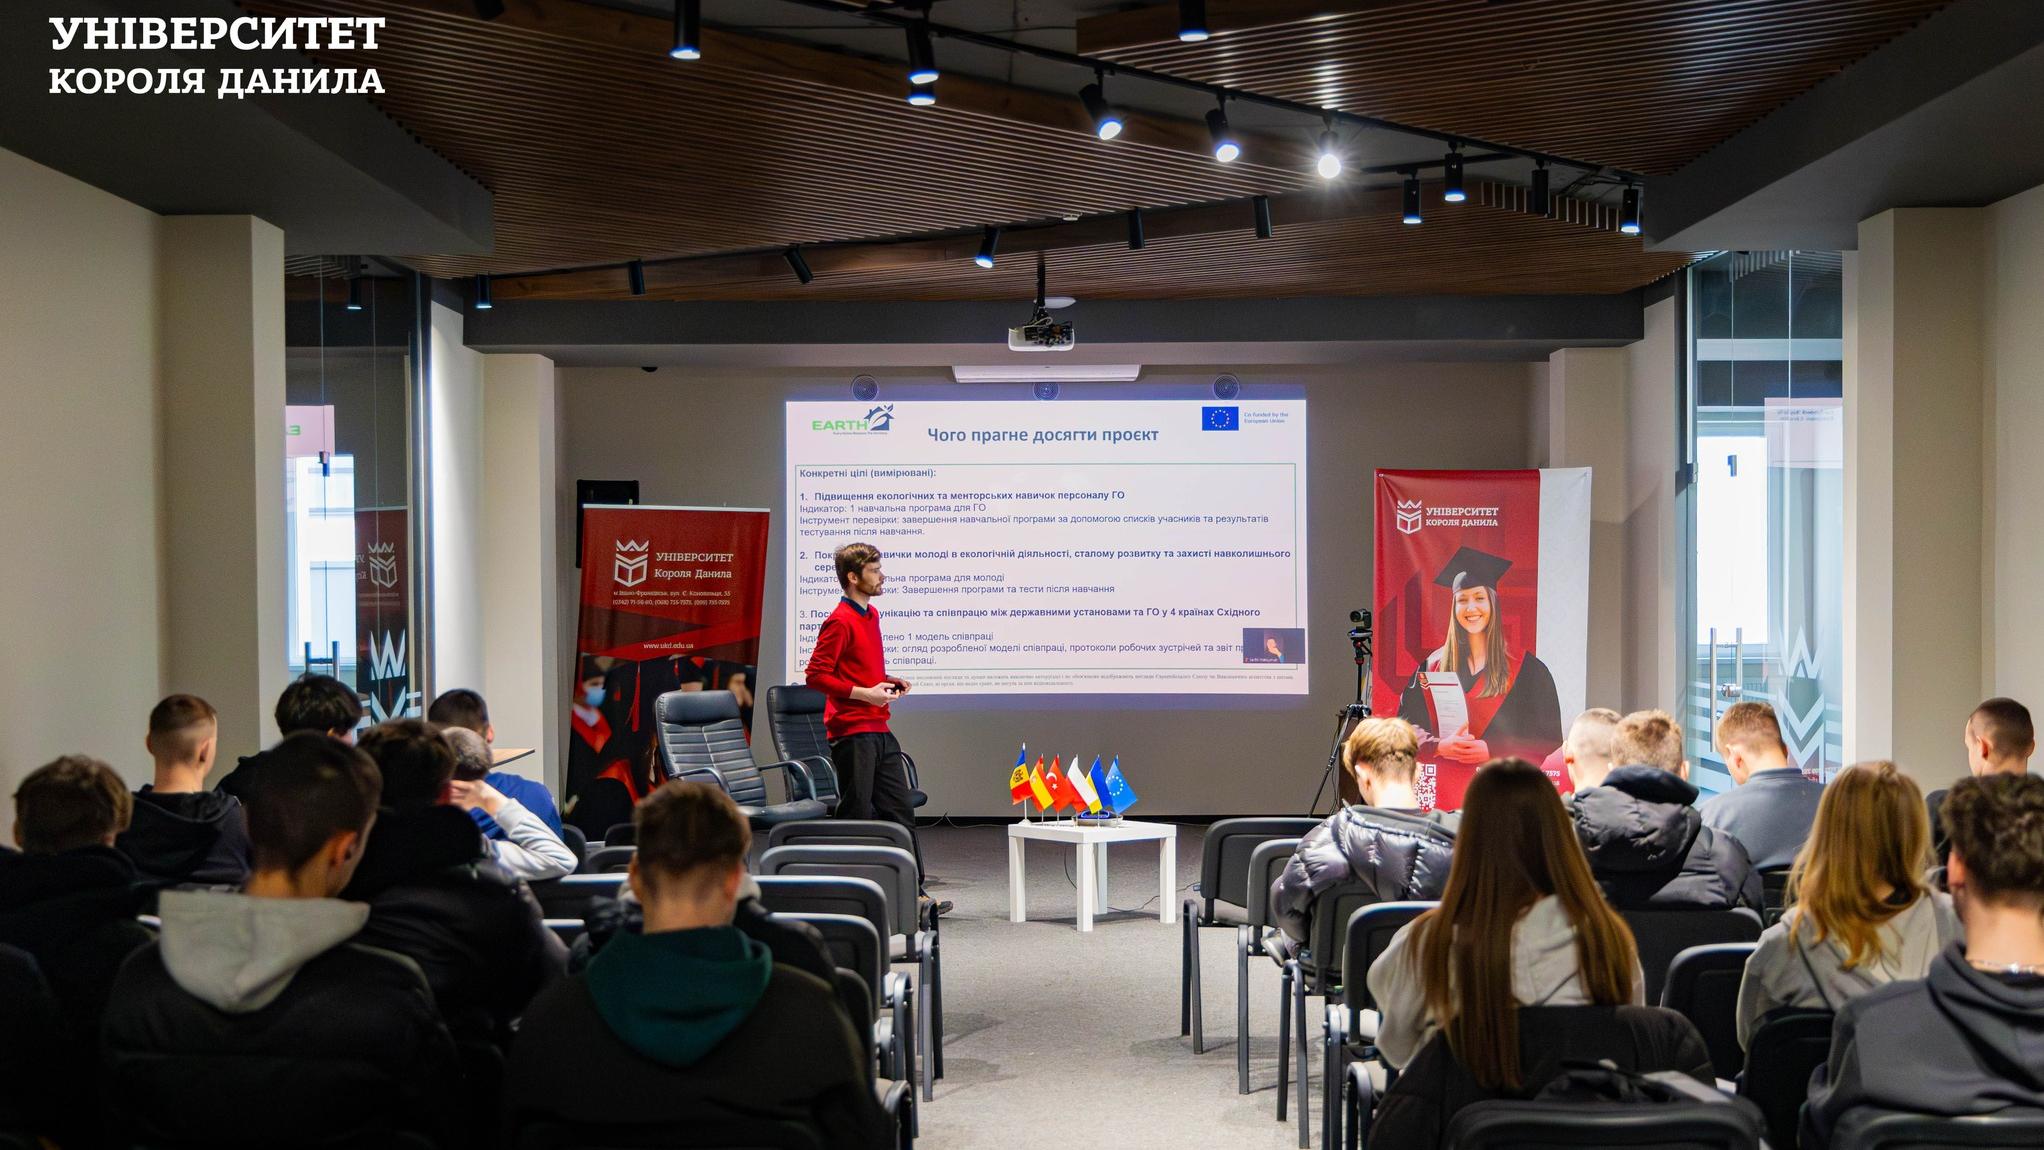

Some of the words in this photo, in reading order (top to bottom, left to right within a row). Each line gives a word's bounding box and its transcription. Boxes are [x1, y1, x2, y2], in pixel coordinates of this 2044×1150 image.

[812, 420, 868, 430] EARTH
[927, 427, 966, 441] Чого
[971, 430, 1028, 444] прагне
[1032, 430, 1097, 444] досягти
[1102, 430, 1159, 444] проєкт
[799, 469, 847, 479] Конкретні
[850, 469, 868, 478] цілі
[870, 468, 936, 479] (вимірювані):
[799, 492, 808, 501] 1.
[814, 492, 874, 502] Підвищення
[876, 492, 934, 500] екологічних
[950, 493, 1012, 502] менторських
[1057, 492, 1109, 501] персоналу
[1111, 491, 1125, 499] ГО
[799, 504, 847, 514] Індикатор:
[908, 505, 951, 514] програма
[953, 505, 970, 513] для
[972, 503, 986, 512] ГО
[1426, 507, 1499, 516] УНІВЕРСИТЕТ
[799, 516, 850, 526] Інструмент
[852, 516, 899, 526] перевірки:
[902, 517, 957, 526] завершення
[959, 515, 1010, 524] навчальної
[1012, 516, 1056, 525] програми
[1069, 516, 1121, 524] допомогою
[1122, 515, 1155, 523] списків
[1157, 514, 1200, 525] учасників
[1215, 514, 1268, 525] результатів
[1425, 519, 1459, 527] КОРОЛЯ
[1461, 519, 1498, 528] ДАНИЛА
[799, 529, 851, 537] тестування
[853, 527, 877, 535] після
[656, 553, 733, 562] УНІВЕРСИТЕТ
[799, 551, 808, 559] 2.
[914, 551, 949, 560] молоді
[959, 550, 1015, 559] екологічній
[1017, 550, 1072, 560] діяльності,
[1074, 552, 1115, 560] сталому
[1117, 551, 1161, 560] розвитку
[1176, 550, 1212, 558] захисті
[655, 569, 691, 580] Короля
[695, 569, 732, 579] Данила
[799, 575, 839, 584] Індикато
[908, 575, 951, 584] програма
[953, 575, 971, 583] для
[972, 573, 1004, 583] молоді
[799, 587, 842, 597] Інструме
[901, 586, 958, 596] Завершення
[961, 587, 1004, 596] програми
[1046, 585, 1070, 593] після
[799, 610, 807, 618] 3.
[879, 609, 920, 619] унікацію
[936, 609, 988, 619] співпрацю
[990, 608, 1008, 617] між
[1009, 610, 1070, 619] державними
[1072, 609, 1131, 618] установами
[1146, 608, 1160, 616] ГО
[1178, 607, 1214, 618] країнах
[1216, 607, 1260, 617] Східного
[915, 634, 950, 642] модель
[951, 632, 994, 642] співпраці
[901, 646, 928, 654] огляд
[930, 644, 987, 655] розробленої
[989, 644, 1020, 654] моделі
[1022, 644, 1067, 654] співпраці,
[1069, 645, 1116, 654] протоколи
[1118, 643, 1156, 654] робочих
[1158, 643, 1201, 654] зустрічей
[1216, 643, 1233, 652] звіт
[892, 656, 936, 666] співпраці.
